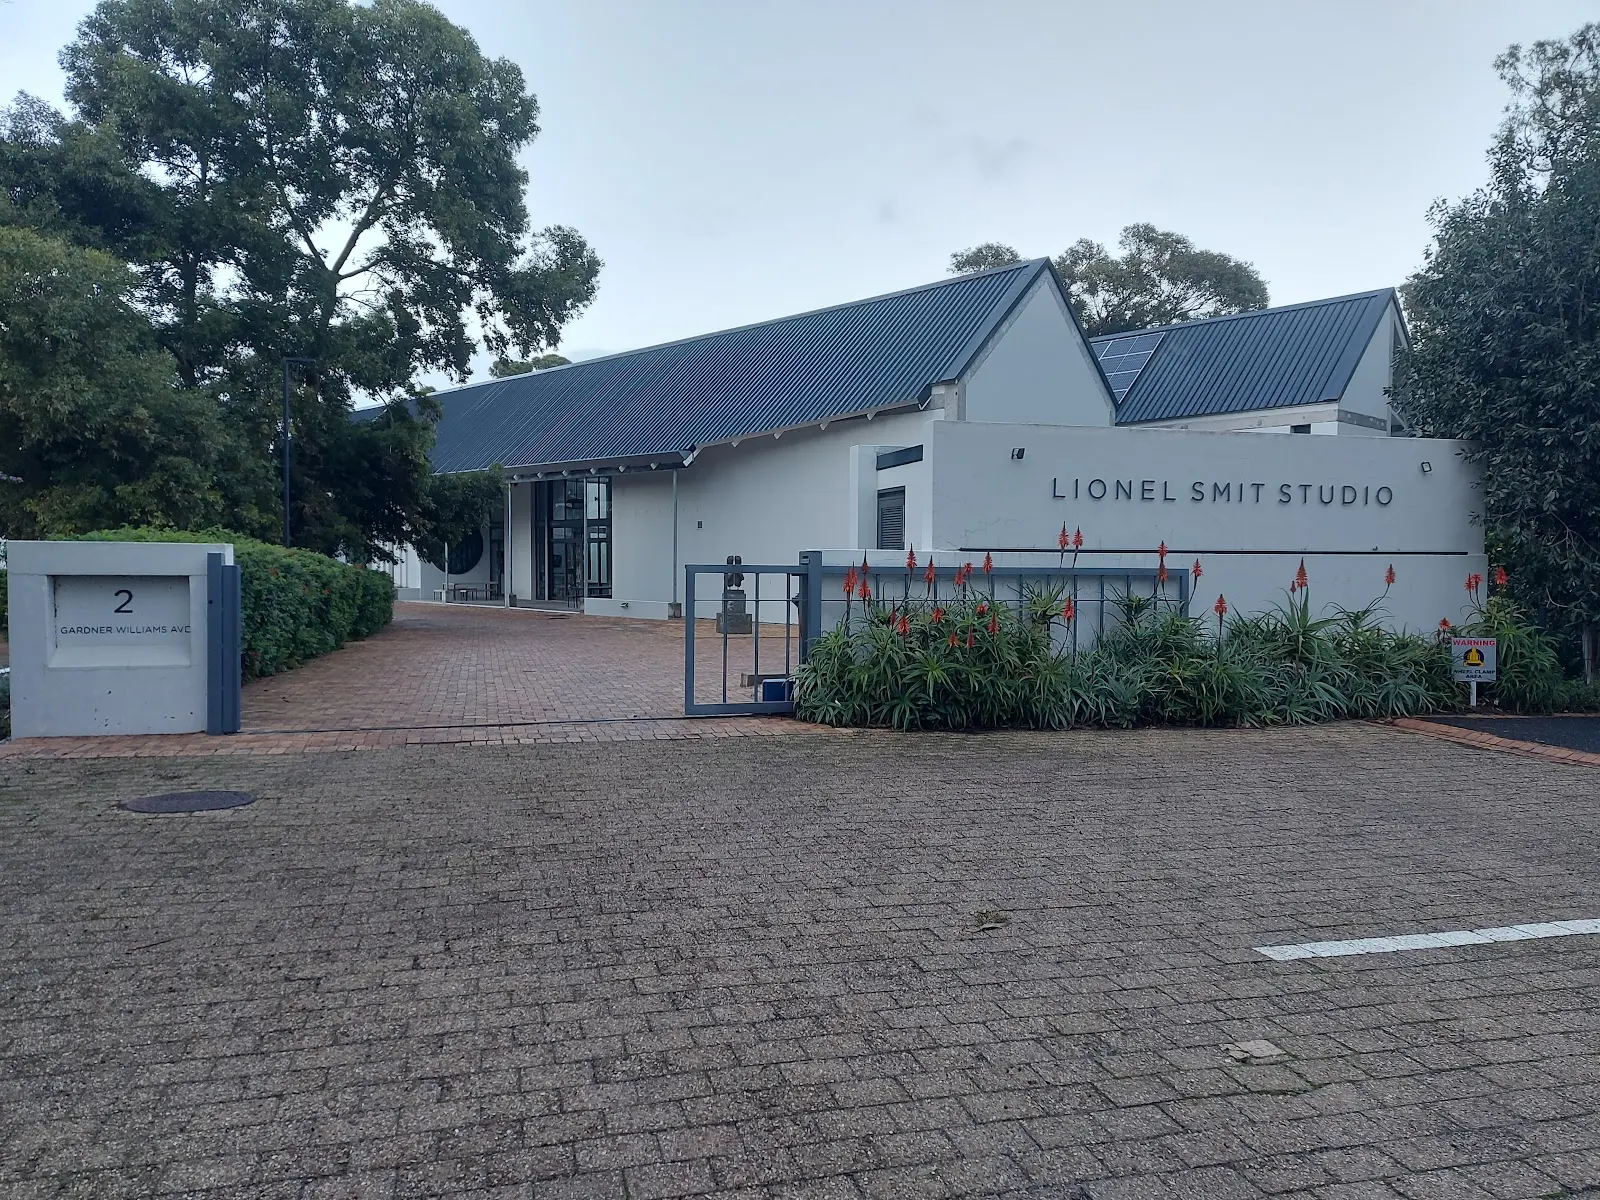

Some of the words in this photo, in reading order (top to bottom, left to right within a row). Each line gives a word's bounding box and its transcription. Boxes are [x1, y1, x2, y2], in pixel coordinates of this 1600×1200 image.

[1052, 477, 1177, 502] LIONEL
[1190, 481, 1266, 504] SMIT
[1278, 483, 1394, 506] STUDIO
[113, 589, 133, 614] 2
[60, 626, 113, 635] GARDNER
[116, 625, 167, 634] WILLIAMS
